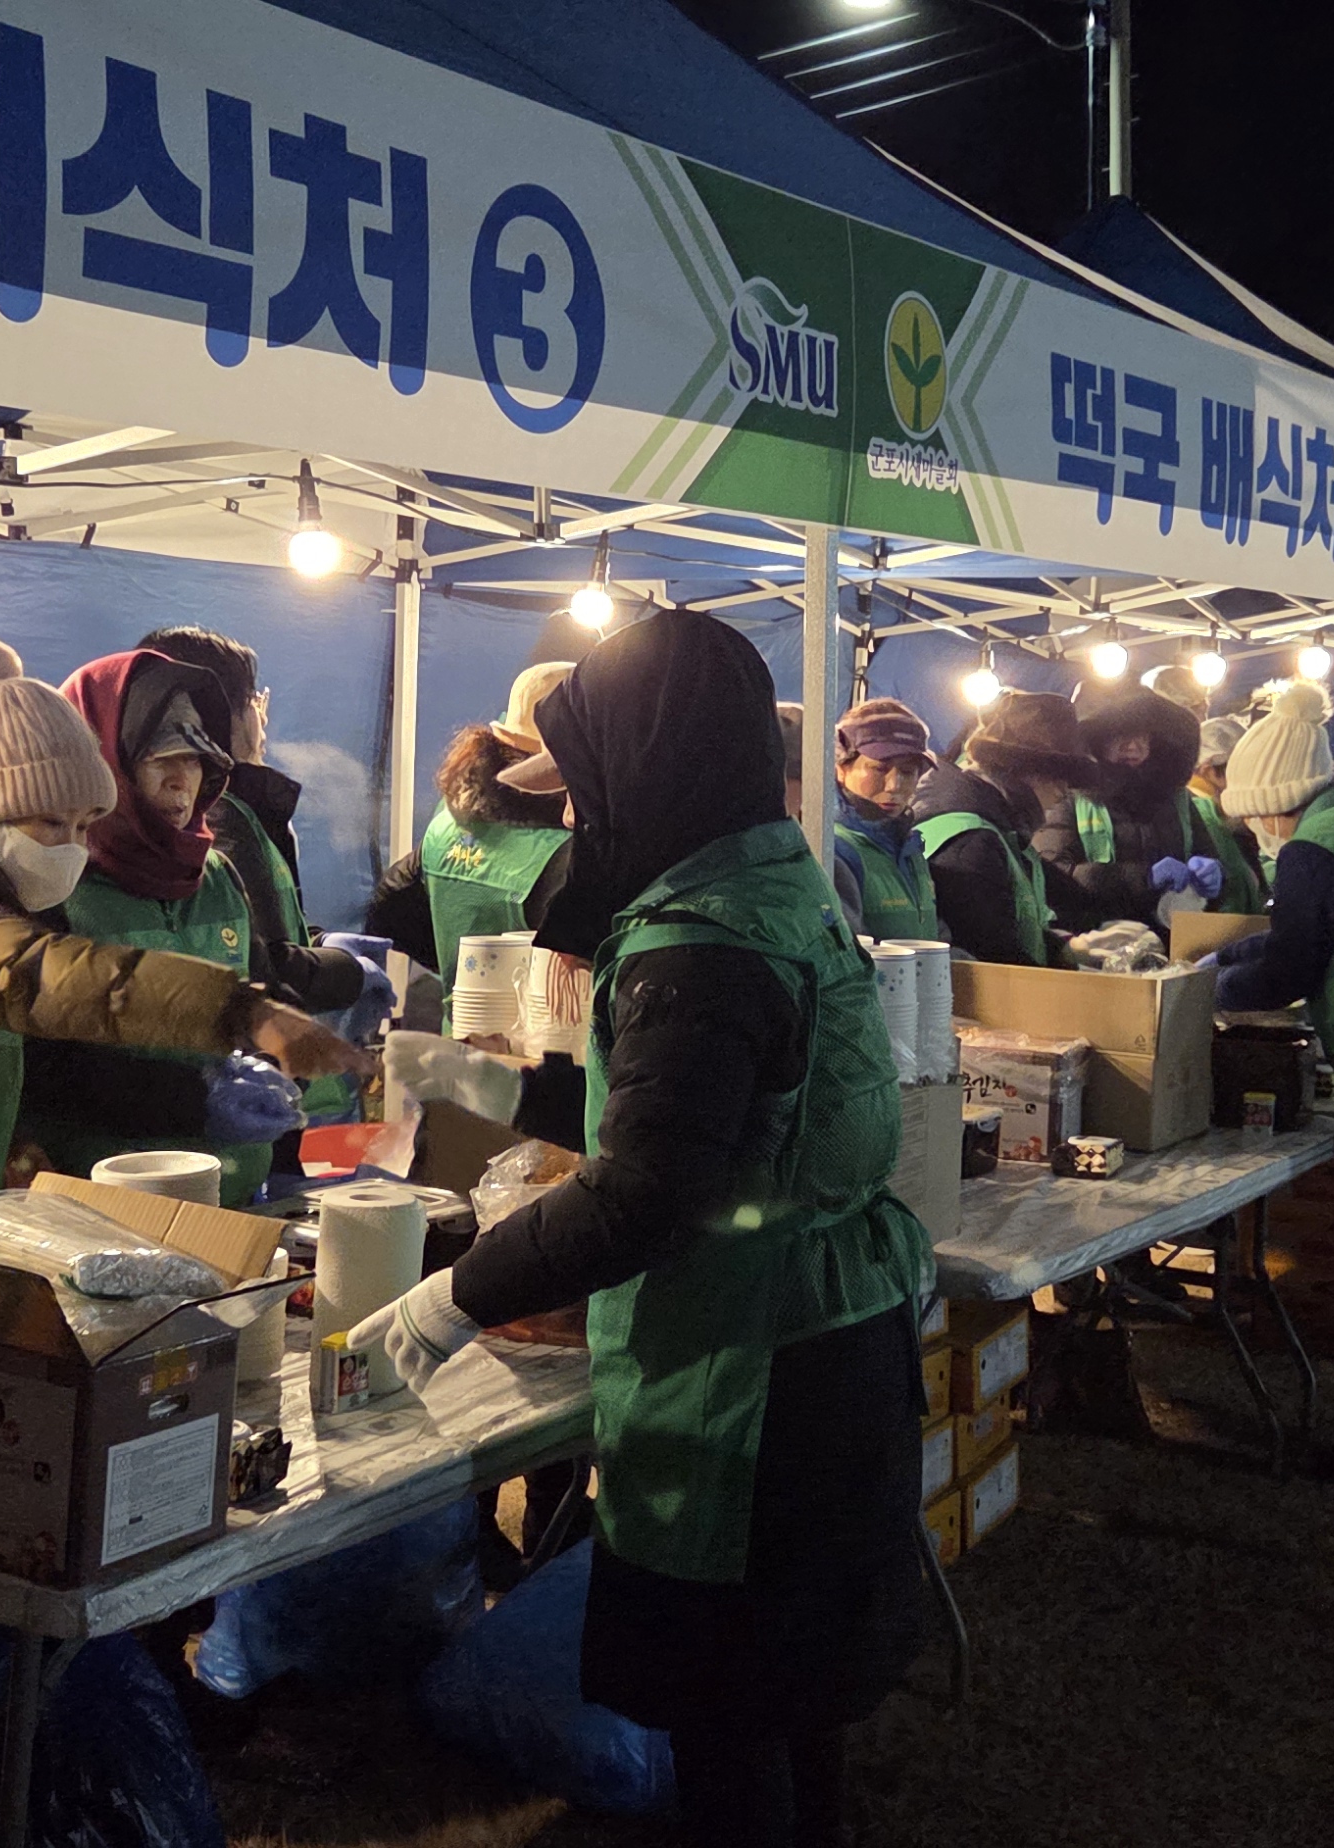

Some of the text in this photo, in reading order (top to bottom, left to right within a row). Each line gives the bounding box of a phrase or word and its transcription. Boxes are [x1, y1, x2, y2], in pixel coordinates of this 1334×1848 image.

[728, 292, 837, 413] SMU
[869, 442, 960, 489] 군포시새마을회
[1050, 351, 1181, 537] 떡국
[961, 1071, 1007, 1104] 추김치
